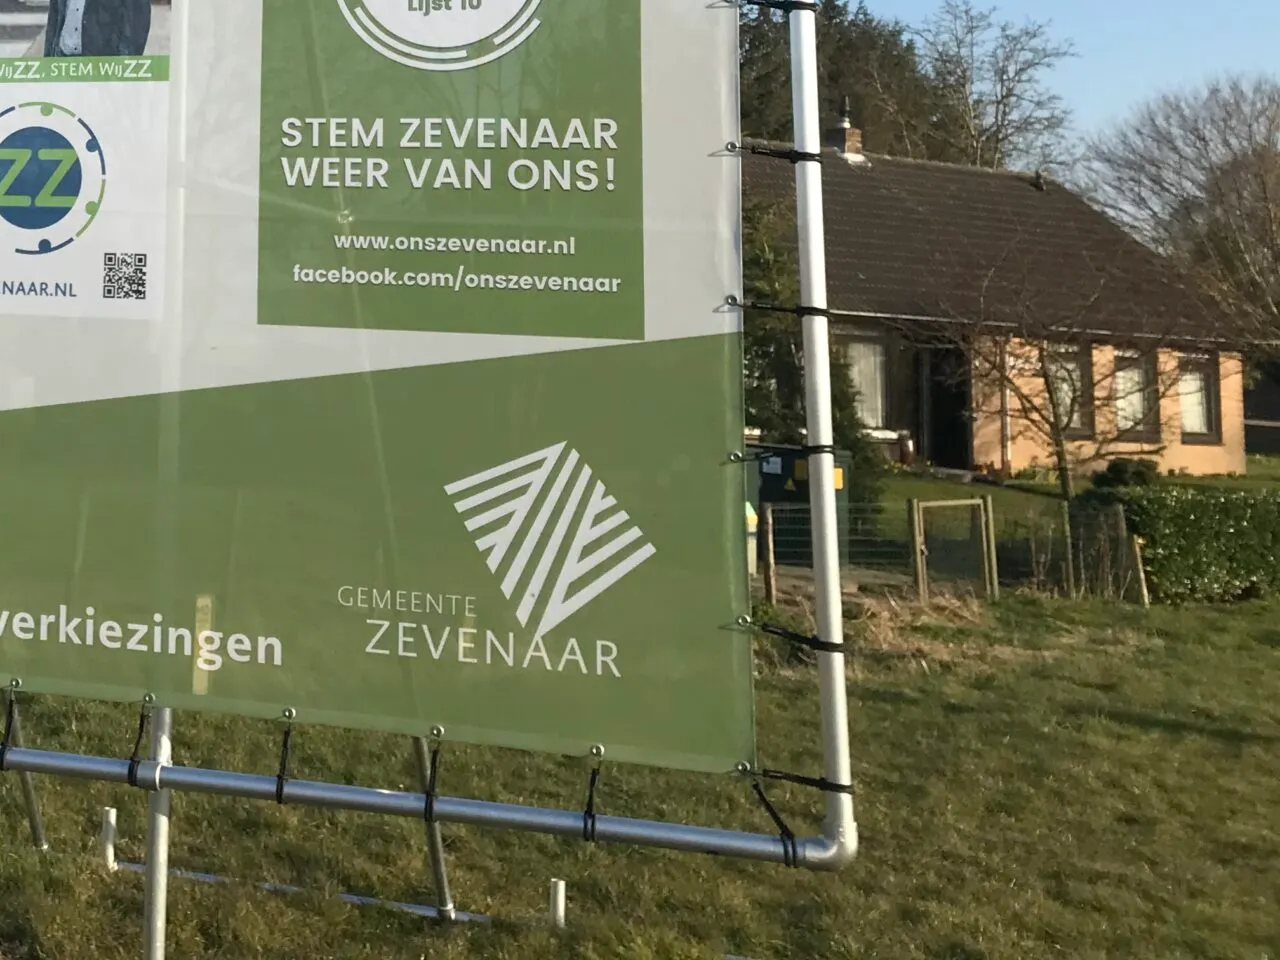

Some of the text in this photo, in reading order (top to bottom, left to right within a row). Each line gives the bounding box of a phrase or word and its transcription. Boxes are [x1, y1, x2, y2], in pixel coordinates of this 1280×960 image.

[50, 62, 92, 77] STEM
[281, 117, 618, 150] STEM ZEVENAAR
[281, 157, 616, 192] WEER VAN ONS!
[334, 234, 576, 255] www.onszevenaar.nl
[293, 264, 621, 292] facebook.com/onszevenaar
[337, 585, 477, 618] GEMEENTE
[365, 619, 622, 677] ZEVENAAR
